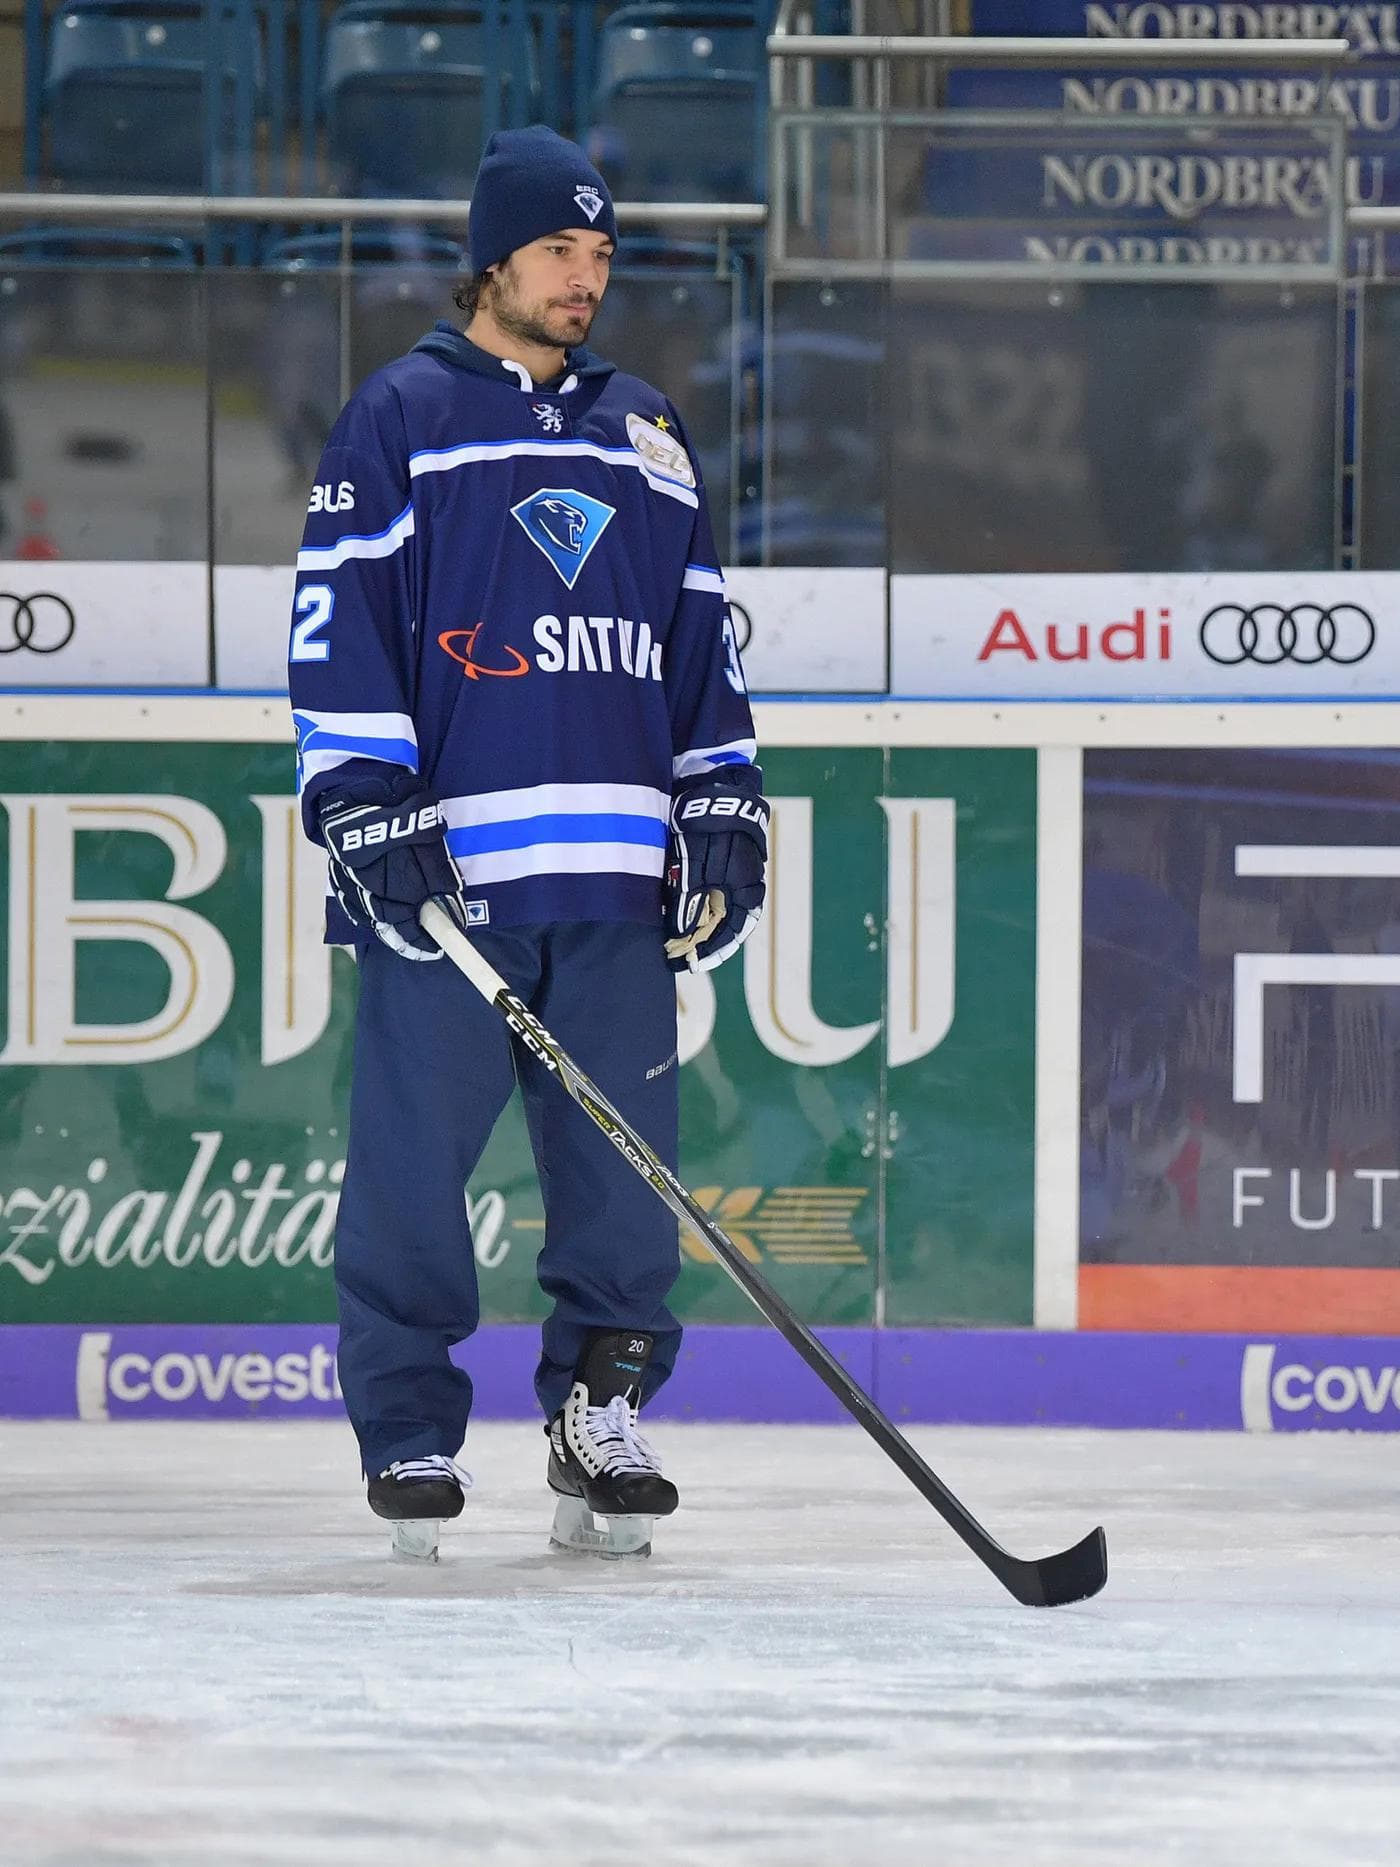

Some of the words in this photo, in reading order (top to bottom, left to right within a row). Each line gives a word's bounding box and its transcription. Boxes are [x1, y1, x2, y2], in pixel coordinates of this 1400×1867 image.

[977, 608, 1172, 662] Audi
[506, 1012, 557, 1072] CCM
[507, 995, 559, 1046] CCM
[583, 1097, 613, 1130] SUPER
[610, 1126, 653, 1178] TACKS
[108, 1344, 343, 1401] covest
[628, 1339, 645, 1353] 20
